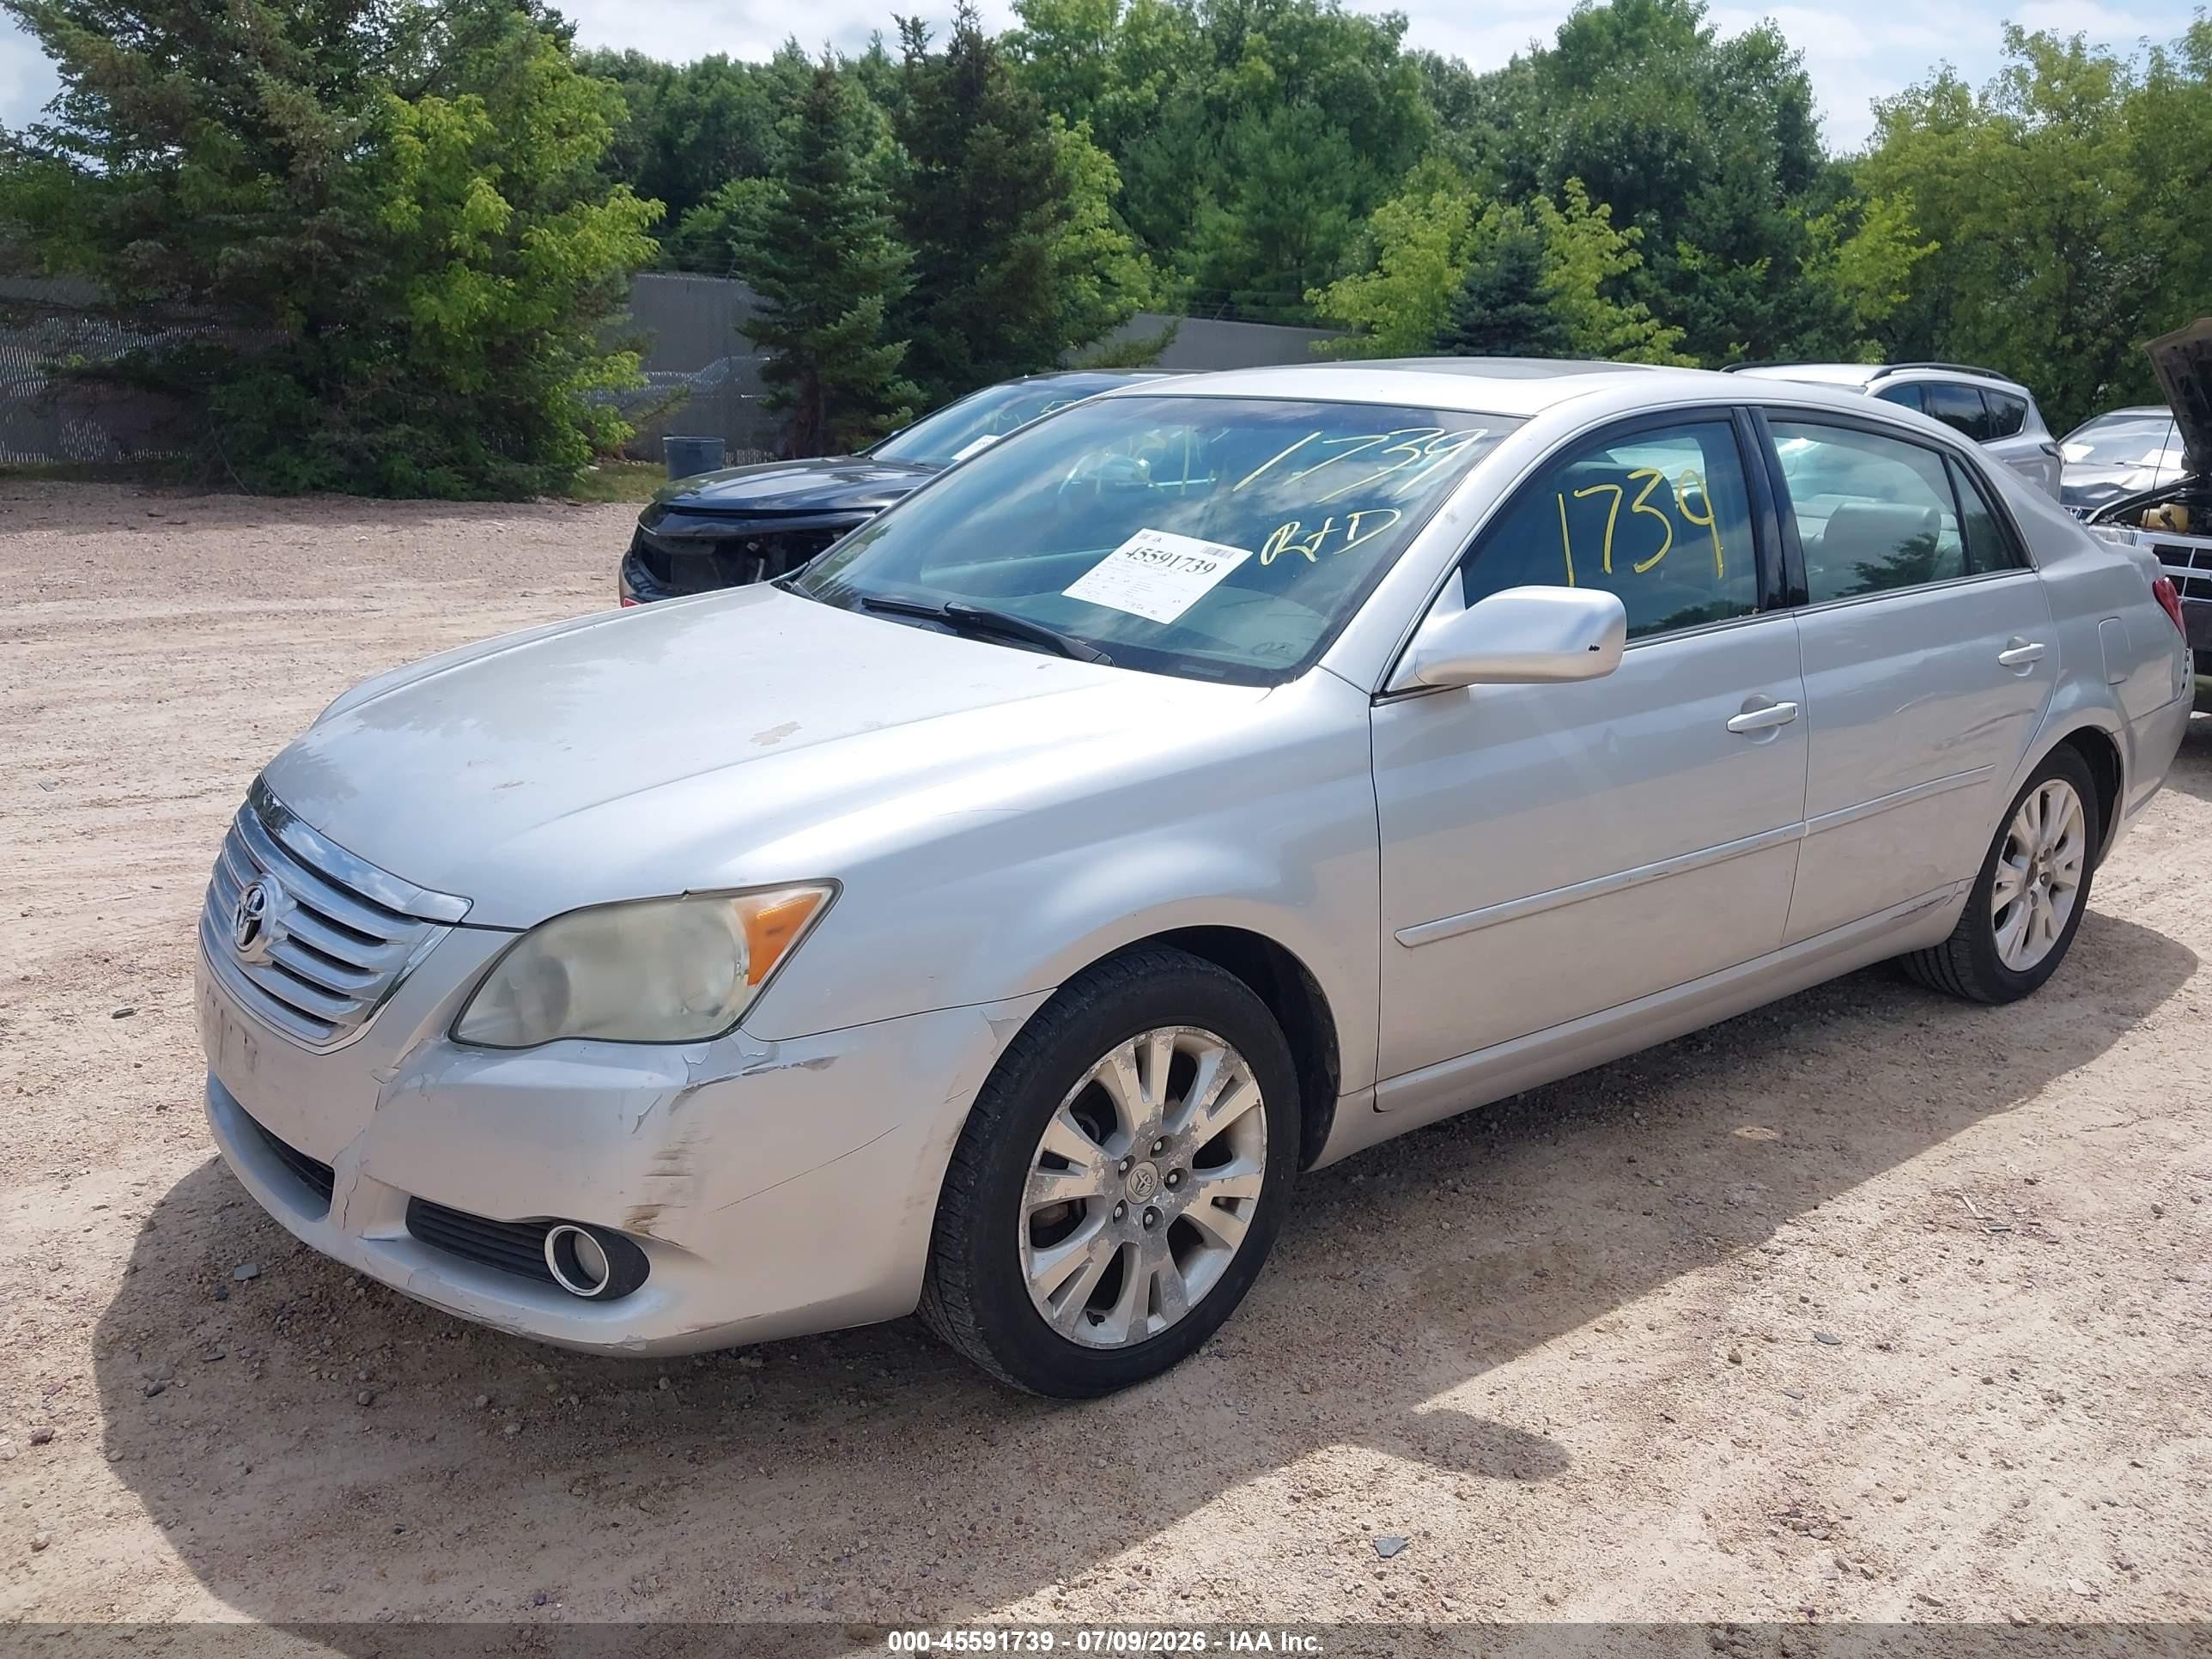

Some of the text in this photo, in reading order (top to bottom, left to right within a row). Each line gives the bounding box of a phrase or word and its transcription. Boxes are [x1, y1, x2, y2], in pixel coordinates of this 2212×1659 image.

[1231, 427, 1489, 504] 1739
[1124, 545, 1218, 575] 45591739
[1555, 468, 1724, 587] 1739
